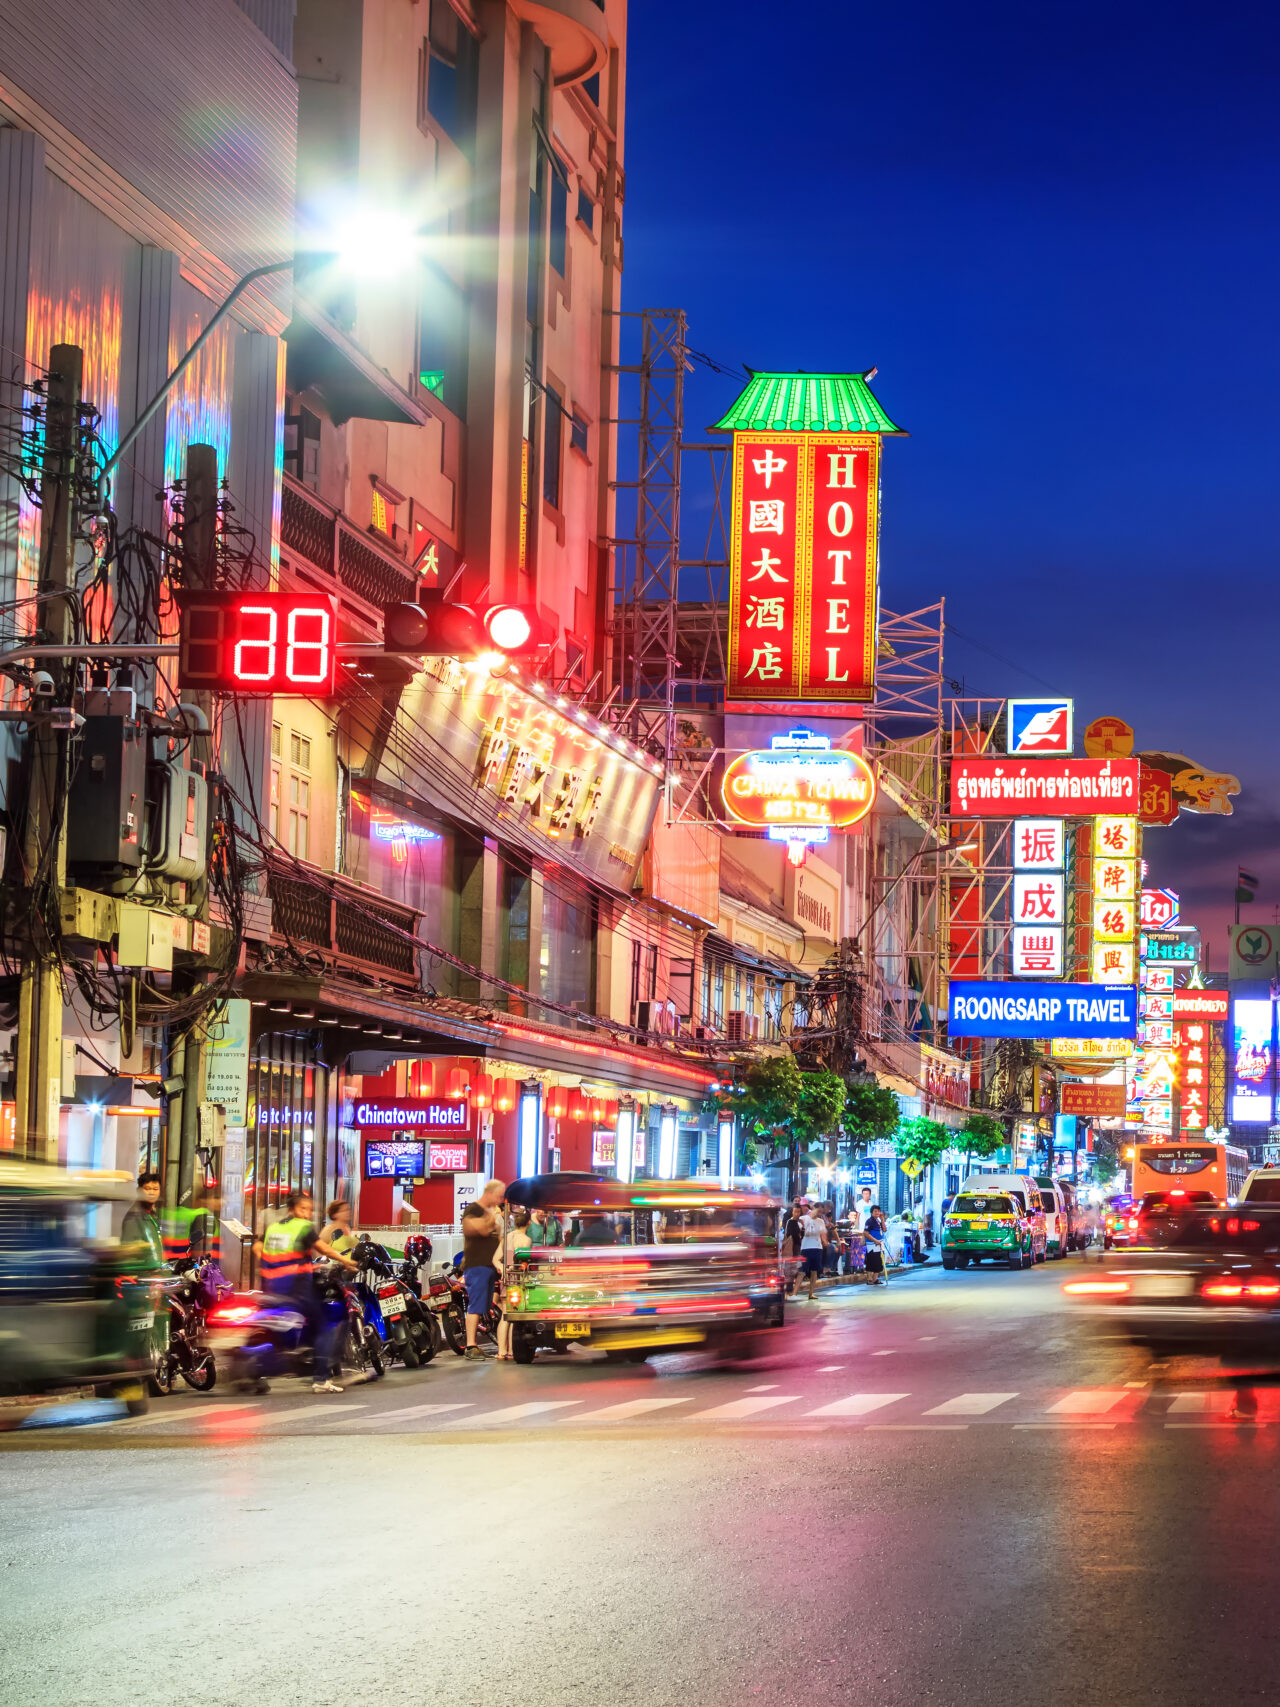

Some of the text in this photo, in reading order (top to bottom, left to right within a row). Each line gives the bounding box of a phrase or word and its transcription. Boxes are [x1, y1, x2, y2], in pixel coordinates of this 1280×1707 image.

[744, 449, 789, 682] 中國大酒店
[825, 453, 857, 683] HOTEL
[957, 760, 1133, 811] รุ่งทรัพย์การท่องเที่ยว
[1020, 827, 1056, 972] 振成豐
[954, 997, 1130, 1022] ROONGSARP TRAVEL
[357, 1103, 465, 1125] Chinatown Hotel
